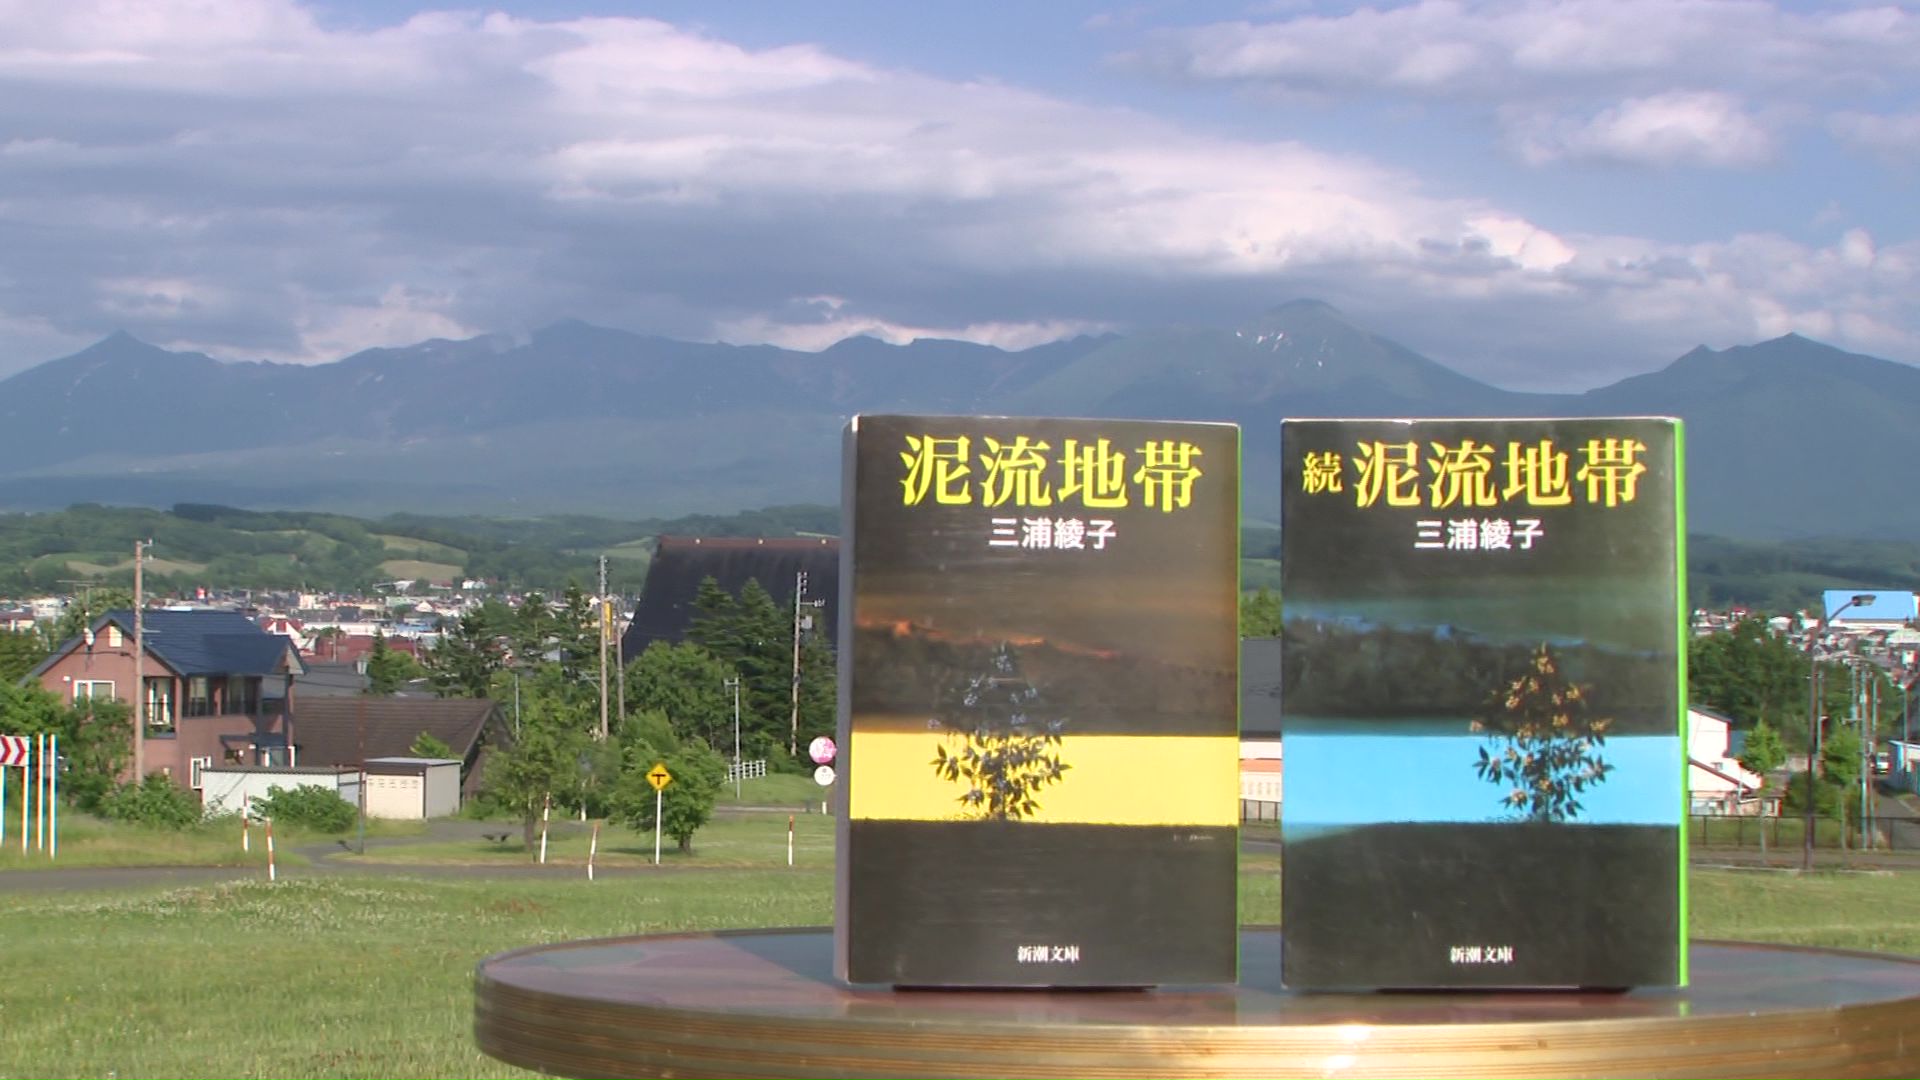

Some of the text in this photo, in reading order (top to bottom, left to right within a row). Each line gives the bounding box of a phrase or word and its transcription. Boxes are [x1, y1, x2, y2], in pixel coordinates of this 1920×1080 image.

[899, 434, 1204, 513] 泥流地帯
[988, 516, 1117, 551] 三浦綾子
[1414, 518, 1544, 552] 三浦綾子
